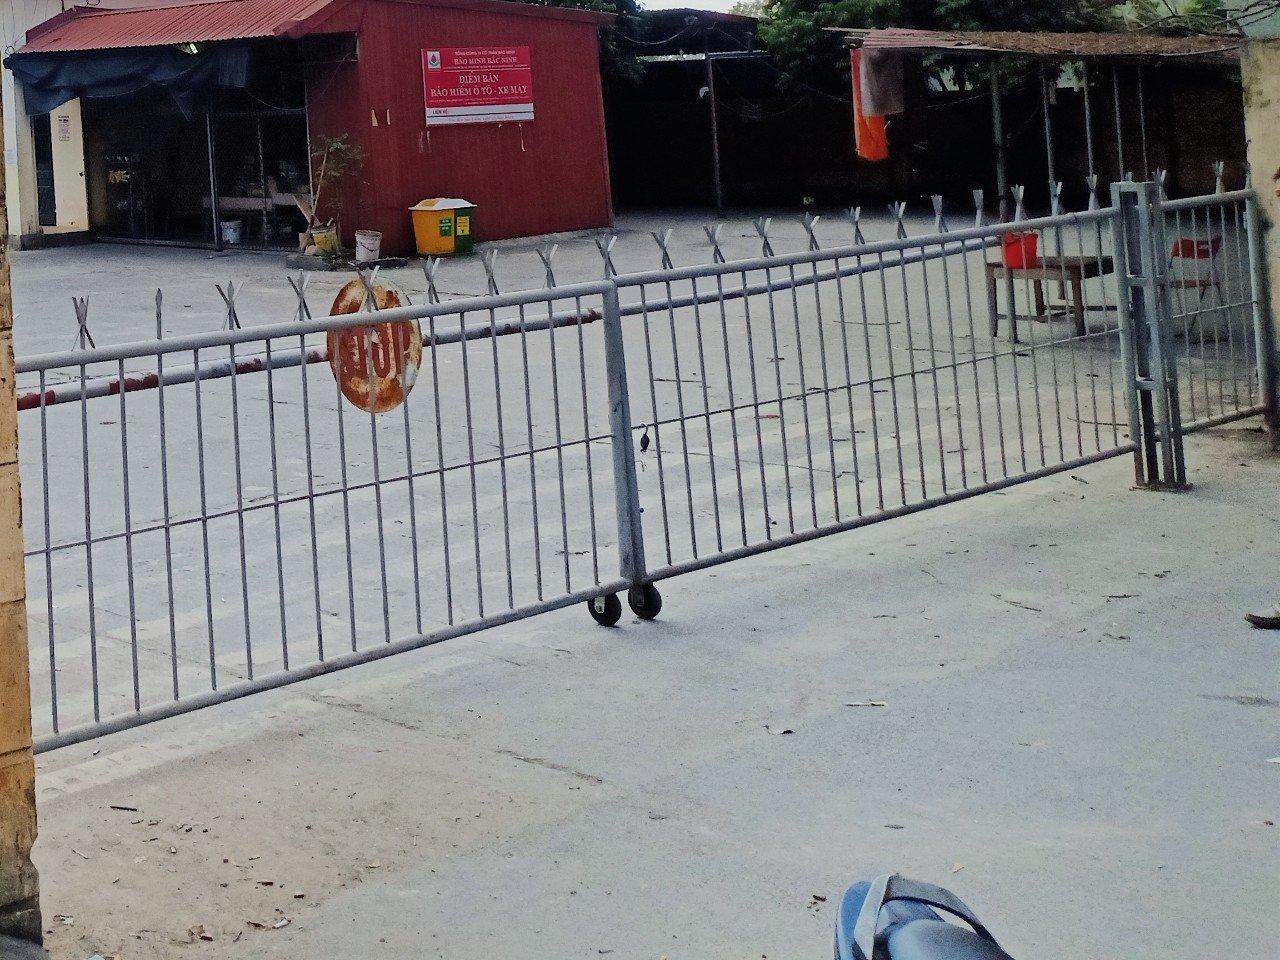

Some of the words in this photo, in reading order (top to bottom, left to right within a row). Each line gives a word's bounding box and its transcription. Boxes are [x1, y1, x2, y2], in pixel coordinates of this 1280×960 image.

[468, 57, 487, 65] MINH
[501, 56, 518, 64] NINH
[482, 73, 499, 83] BÁN
[431, 86, 448, 97] BẢO
[498, 85, 509, 95] XE
[511, 83, 528, 94] MÁY
